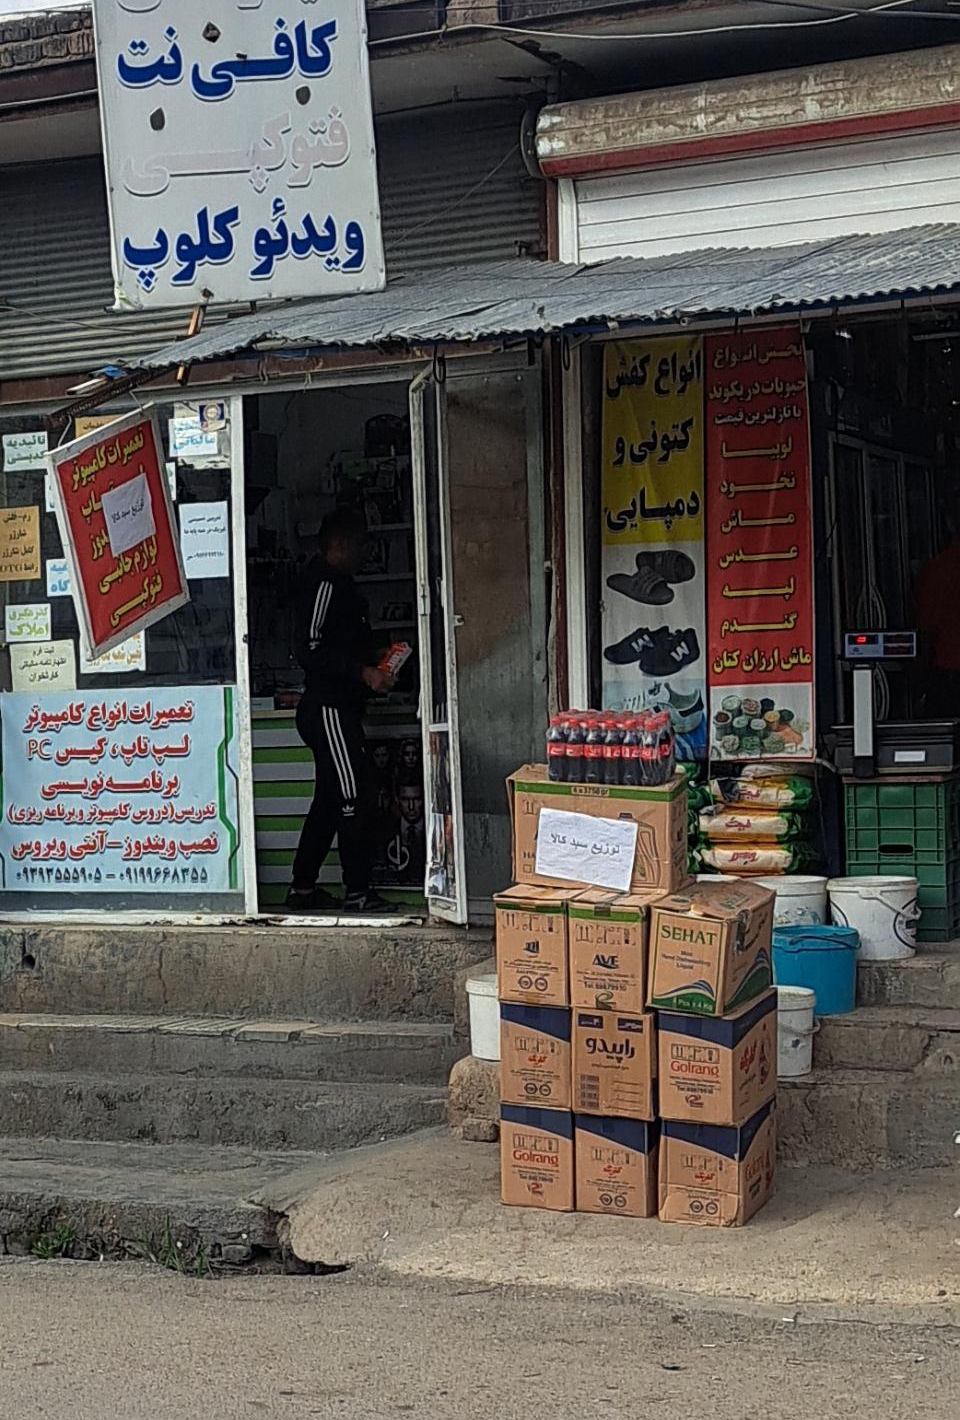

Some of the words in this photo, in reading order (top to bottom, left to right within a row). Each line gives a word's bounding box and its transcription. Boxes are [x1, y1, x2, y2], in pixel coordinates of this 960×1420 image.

[116, 23, 184, 89] نت
[191, 17, 337, 101] کافی
[122, 205, 239, 291] کلوپ
[250, 197, 367, 279] ویدئو
[714, 343, 757, 369] انواع
[606, 353, 650, 397] کفش
[654, 348, 701, 395] انواع
[762, 377, 806, 400] حبوبات
[106, 426, 144, 466] تعمیرات
[612, 436, 625, 466] و
[629, 417, 694, 464] کتونی
[722, 436, 793, 459] لوبیا
[72, 443, 107, 492] کامپیوتر
[720, 471, 796, 497] نخود
[606, 487, 700, 530] دمپایی
[720, 509, 796, 534] ماش
[719, 545, 799, 568] عدس
[100, 555, 132, 595] جانبی
[722, 576, 796, 600] لپه
[8, 622, 49, 637] املاک
[720, 611, 798, 638] گندم
[742, 648, 780, 672] ارزان
[780, 650, 813, 672] ماش
[23, 702, 86, 732] کامپیوتر
[86, 701, 128, 730] انواع
[129, 700, 194, 730] تعمیرات
[26, 738, 53, 759] PC
[55, 736, 107, 766] کیس
[151, 734, 191, 765] لپ
[40, 770, 105, 799] نویسی
[106, 770, 180, 799] برنامه
[86, 802, 131, 825] کامپیوتر
[10, 836, 67, 862] ویروس
[178, 831, 220, 857] نصب
[550, 833, 567, 845] کالا
[569, 837, 588, 850] سبد
[590, 842, 620, 857] توزیع
[660, 924, 718, 947] SEHAT
[592, 954, 620, 967] AVE
[585, 1036, 636, 1064] راپیدو
[670, 1060, 720, 1078] Golrang
[512, 1149, 559, 1168] Golrang
